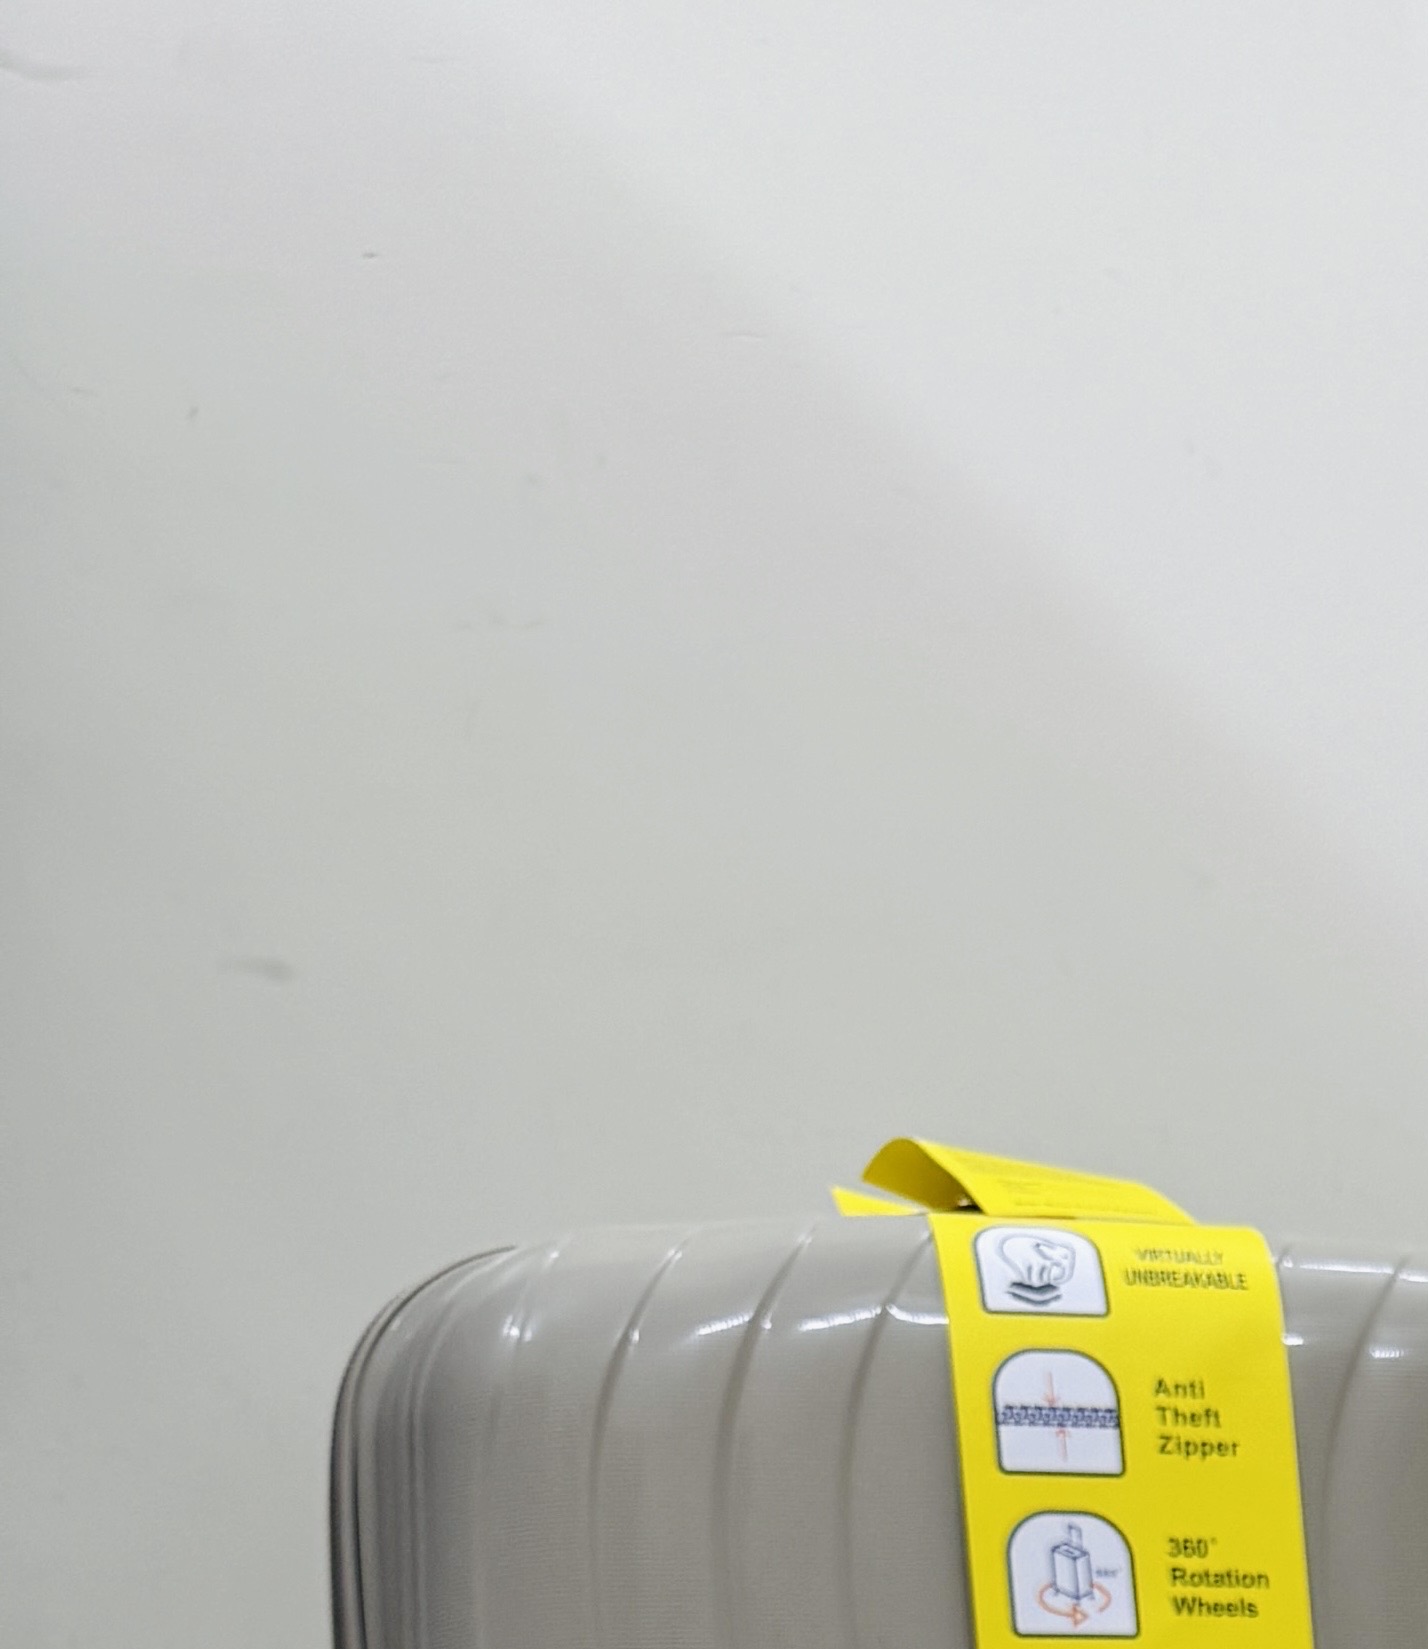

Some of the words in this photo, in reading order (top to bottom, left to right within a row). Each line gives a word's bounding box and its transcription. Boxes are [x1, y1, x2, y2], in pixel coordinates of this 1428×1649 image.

[1135, 1247, 1224, 1266] VIRTUALLY
[1125, 1268, 1248, 1291] UNBREAKABLE
[1154, 1377, 1205, 1400] Anti
[1155, 1405, 1221, 1428] Theft
[1158, 1434, 1239, 1460] Zipper
[1170, 1566, 1270, 1589] Rotation
[1172, 1596, 1259, 1618] Wheels
